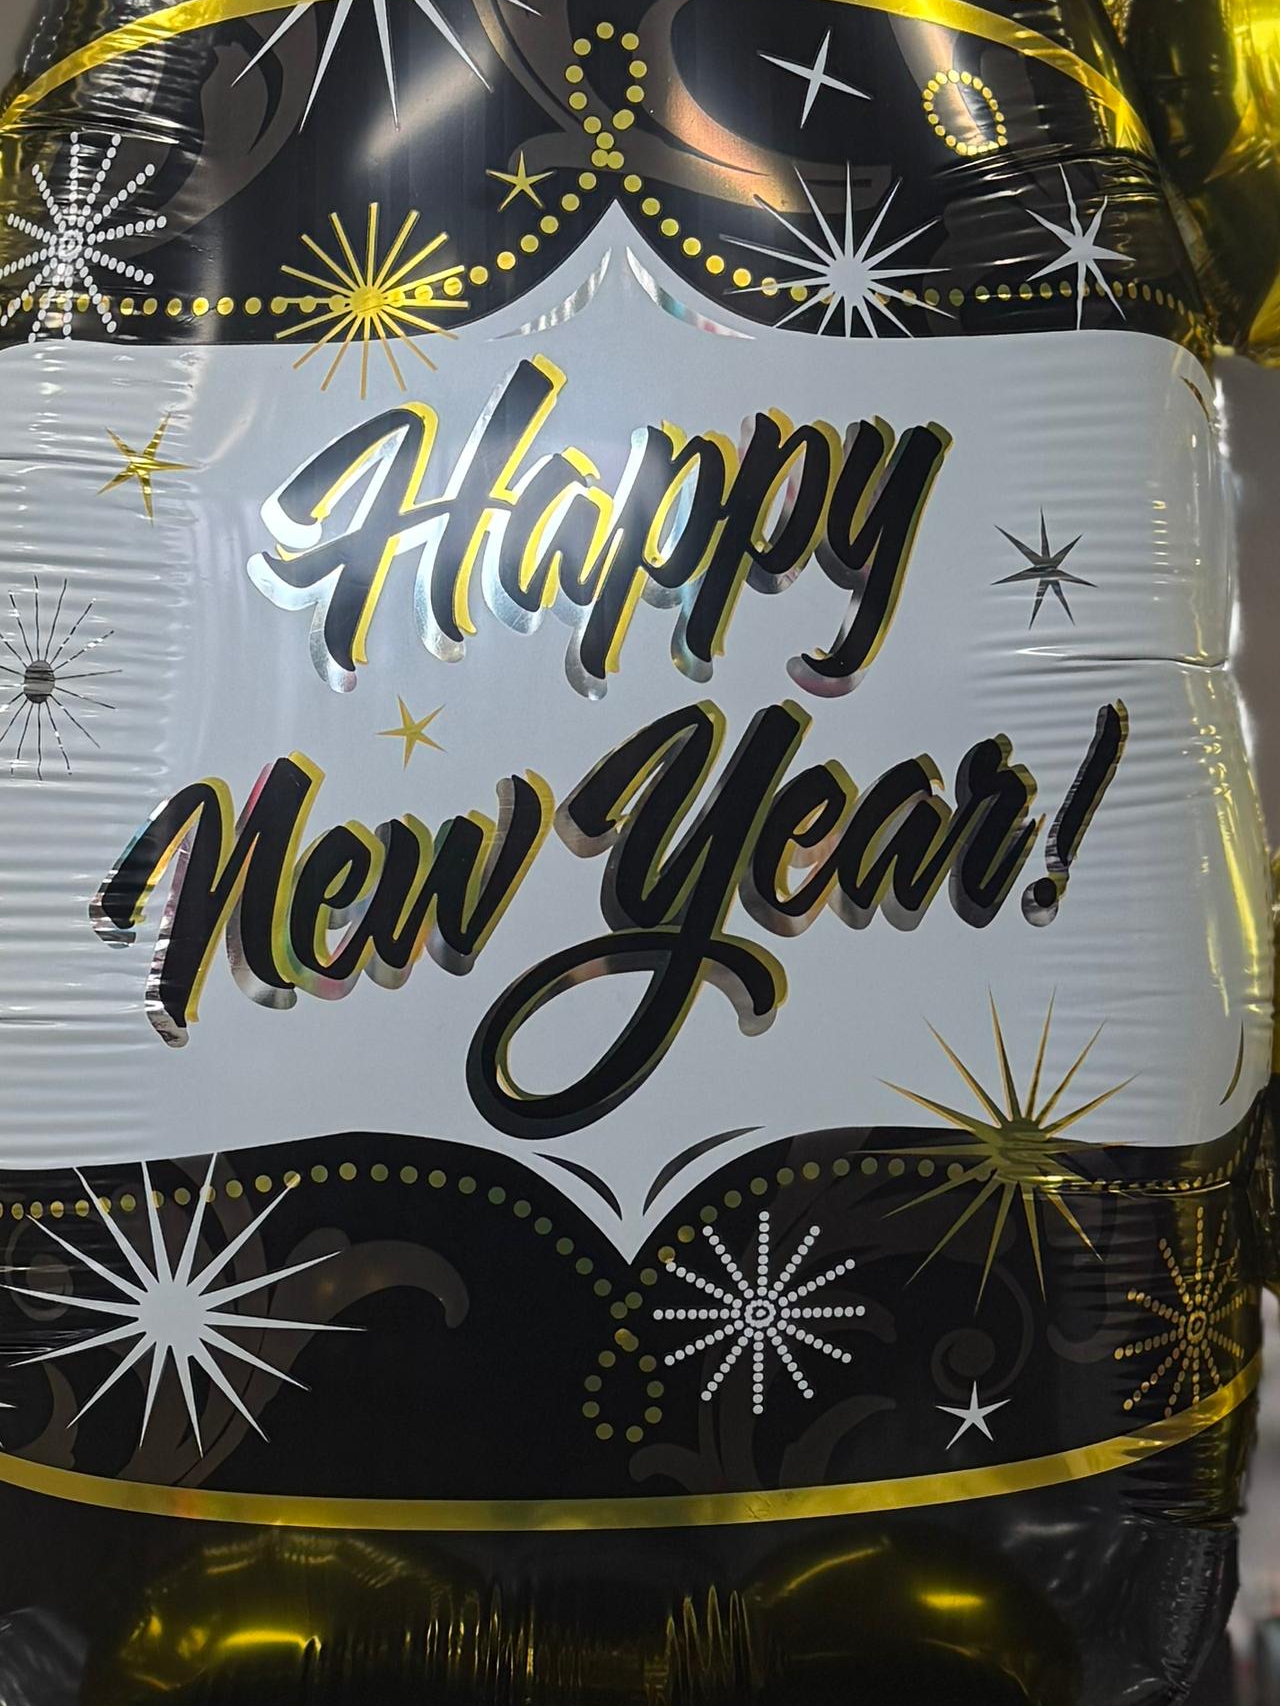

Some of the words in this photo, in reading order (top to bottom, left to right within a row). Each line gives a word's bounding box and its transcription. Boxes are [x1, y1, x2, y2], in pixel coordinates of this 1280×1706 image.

[249, 353, 954, 699] Happy
[89, 751, 556, 1048] New
[467, 698, 1131, 1141] Year!
